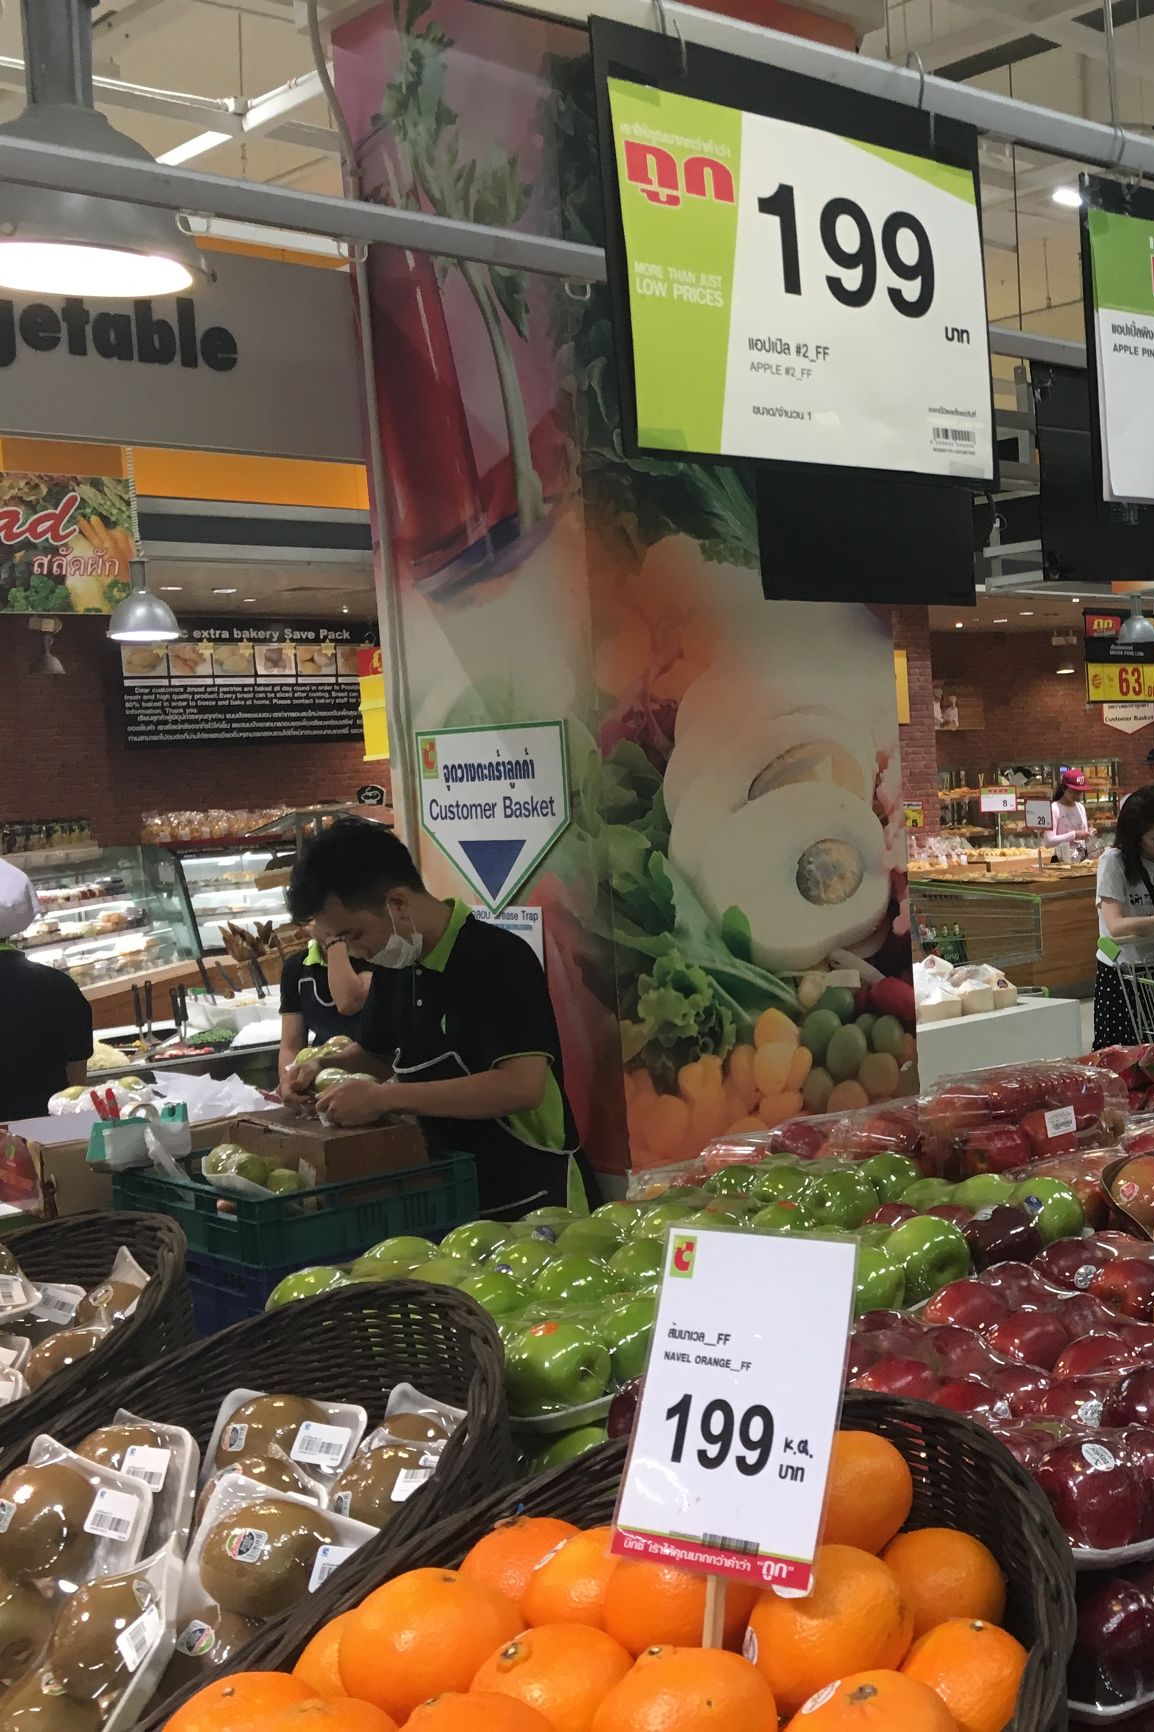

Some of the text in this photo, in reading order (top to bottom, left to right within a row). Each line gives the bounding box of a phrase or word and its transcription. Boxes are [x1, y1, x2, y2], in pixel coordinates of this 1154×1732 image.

[758, 183, 936, 319] 199
[634, 261, 723, 288] MORE THAN JUST
[636, 277, 724, 309] LOW PRICES
[944, 326, 971, 346] บาท
[1112, 343, 1139, 356] APPLE
[749, 360, 782, 377] APPLE
[193, 627, 351, 642] extra bakery Save Pack
[429, 796, 557, 822] Customer Basket
[521, 910, 539, 924] Trap
[664, 1350, 692, 1365] NAVEL
[665, 1393, 775, 1478] 199
[778, 1463, 806, 1483] บาท
